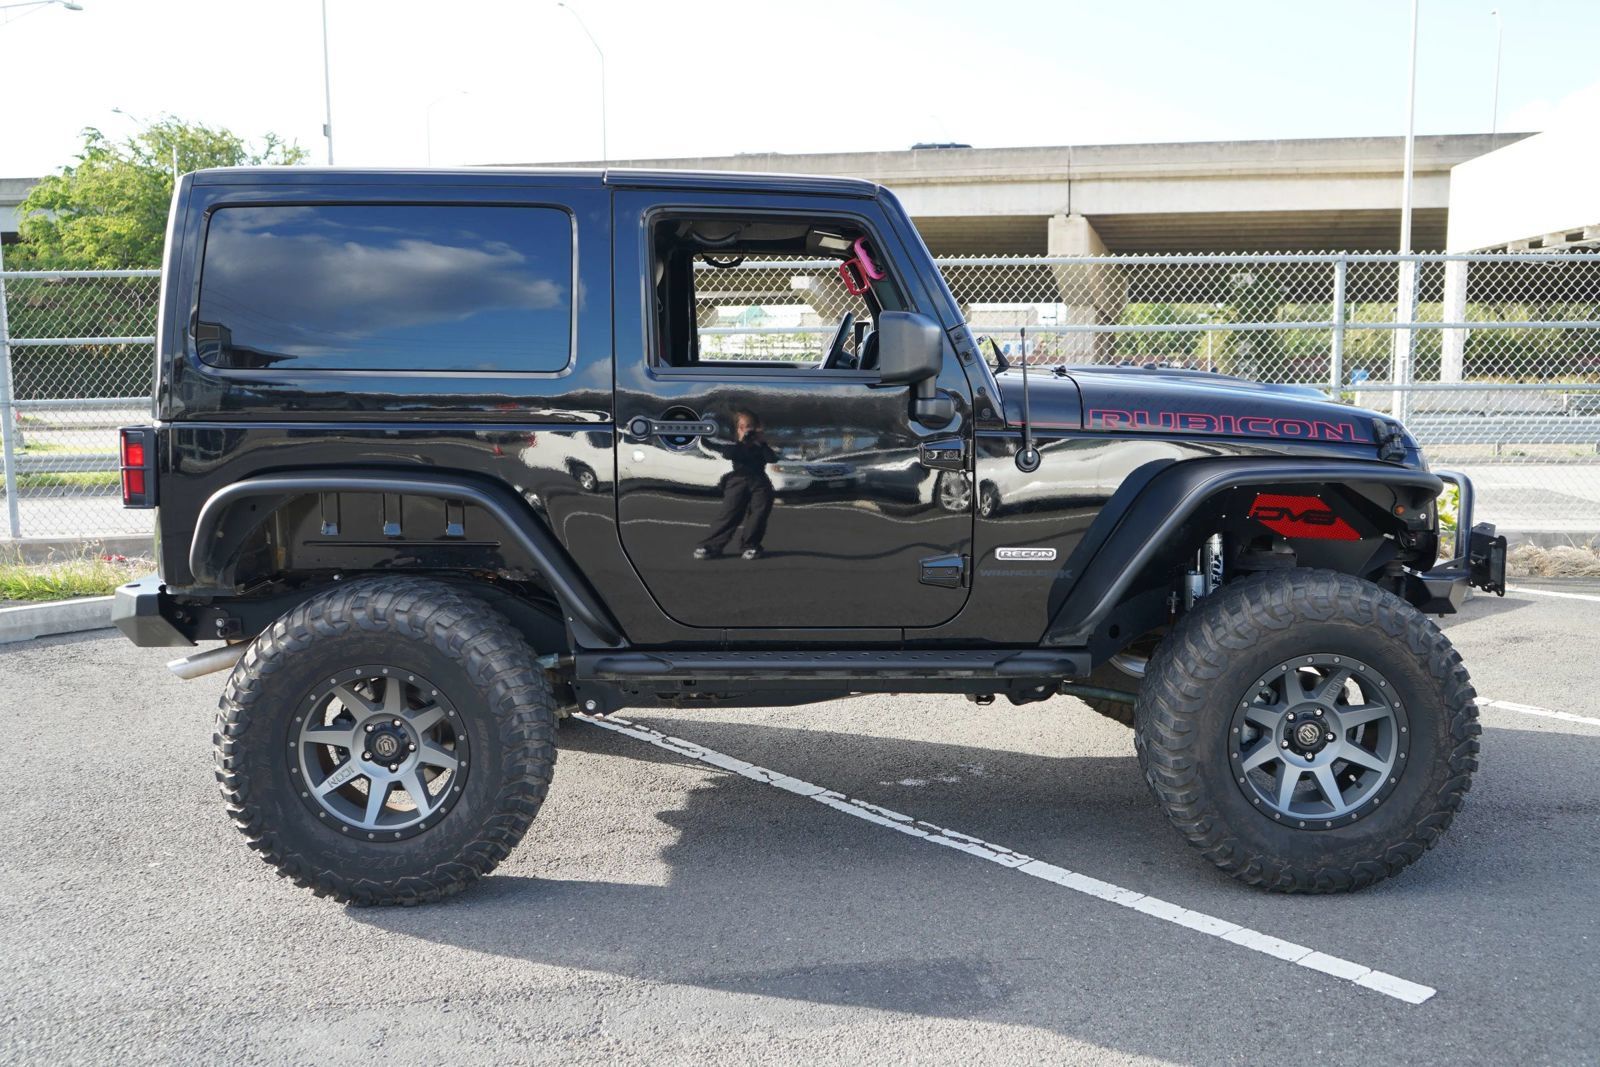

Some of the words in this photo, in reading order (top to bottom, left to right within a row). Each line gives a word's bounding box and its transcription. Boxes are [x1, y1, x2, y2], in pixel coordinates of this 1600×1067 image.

[1088, 409, 1369, 442] RUBICON
[1000, 550, 1053, 558] RECON
[327, 765, 355, 788] ICON
